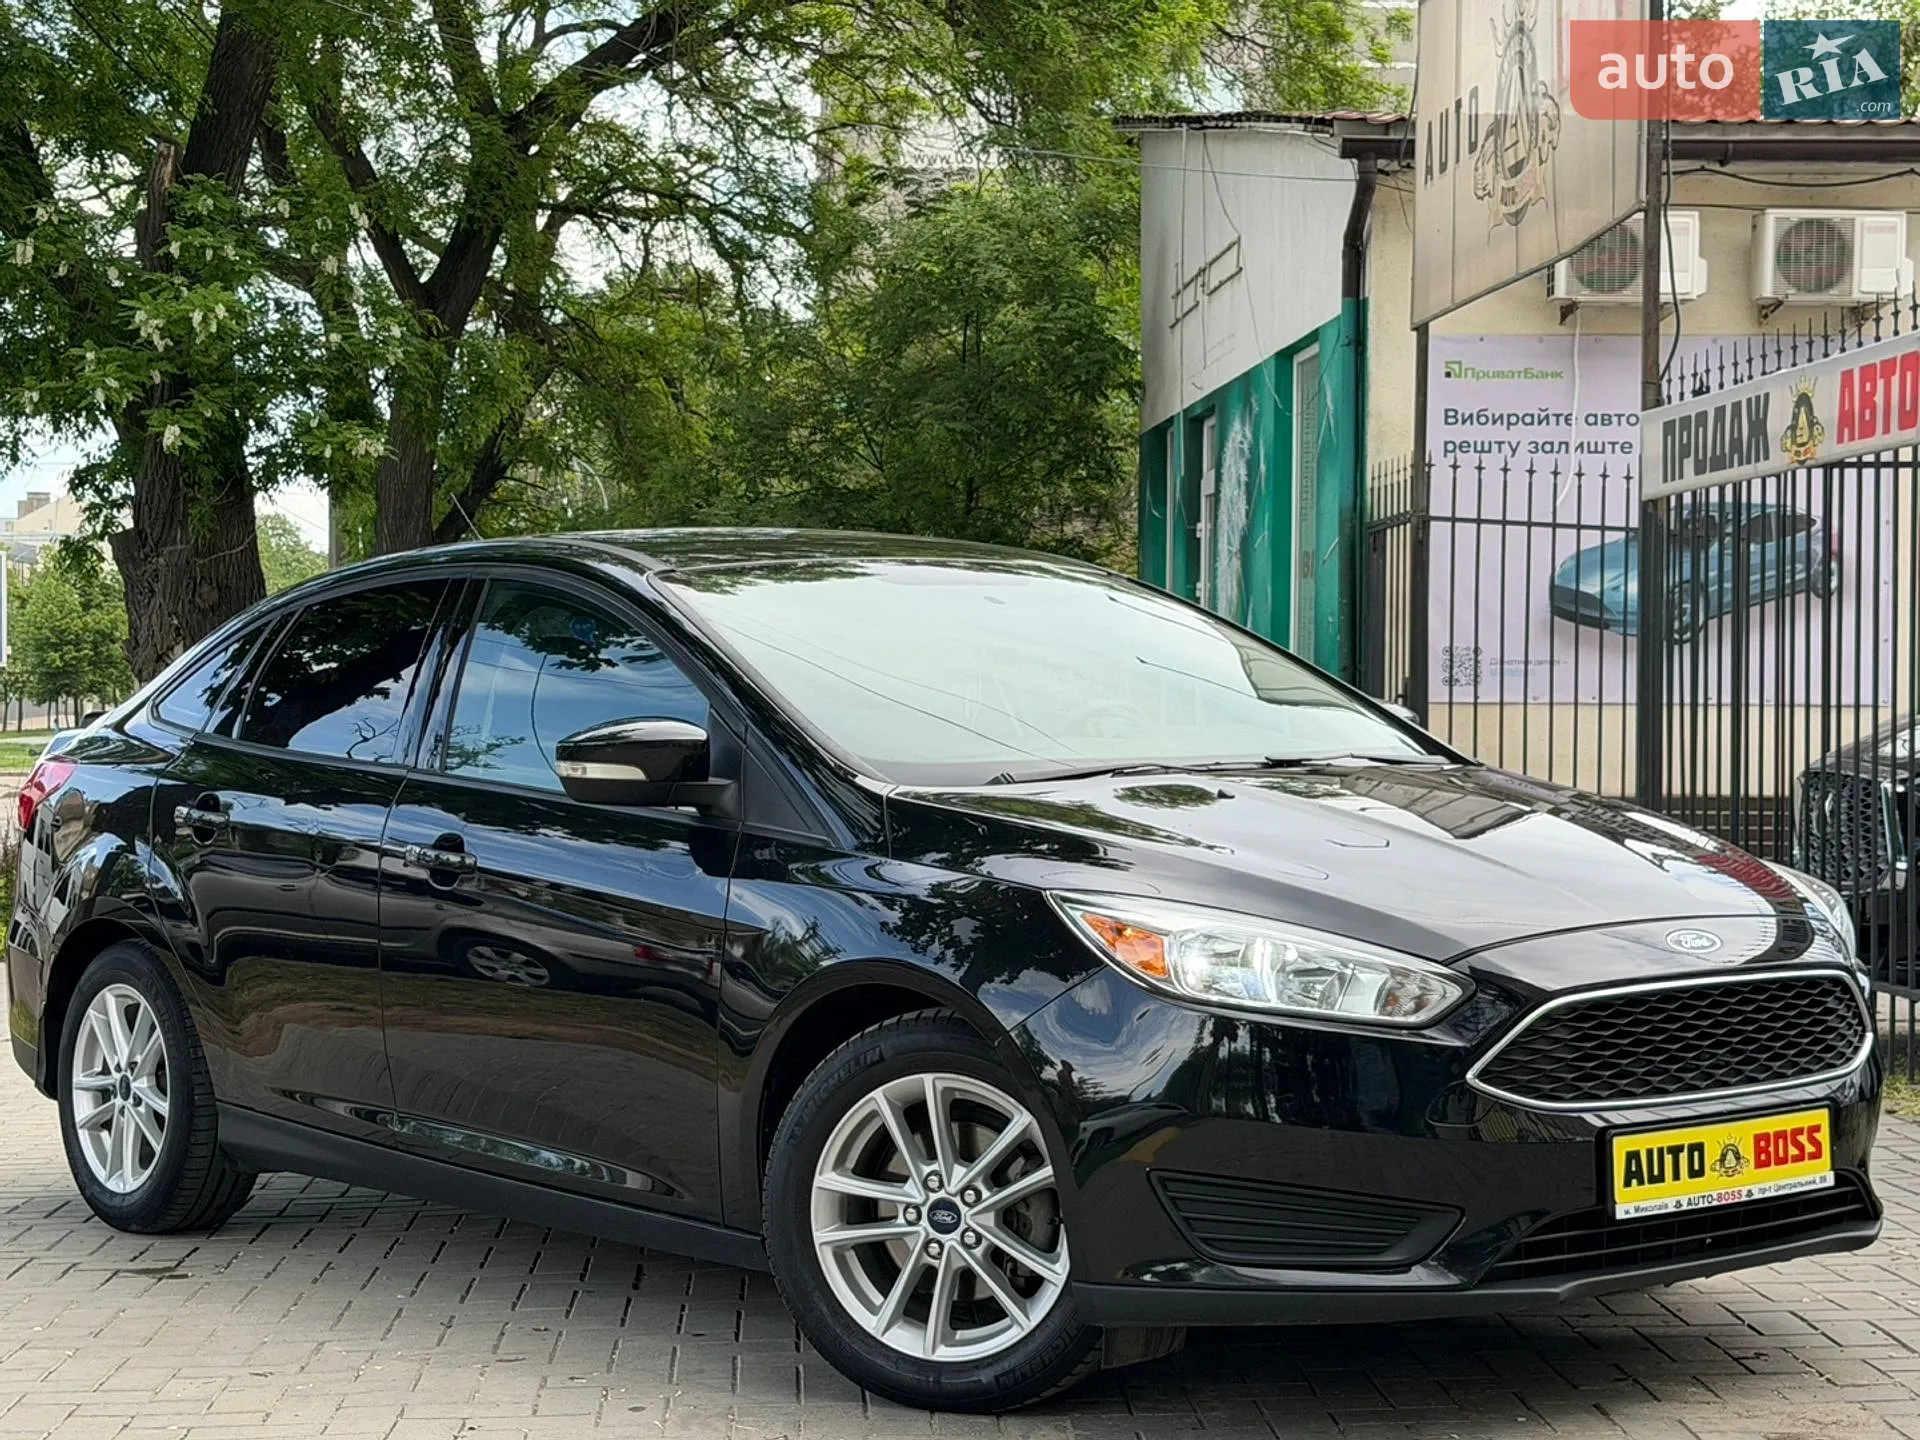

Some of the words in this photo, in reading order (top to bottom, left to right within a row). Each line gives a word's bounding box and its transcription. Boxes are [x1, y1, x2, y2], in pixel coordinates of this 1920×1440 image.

[1424, 85, 1479, 187] AUTO
[1463, 367, 1564, 382] ПриватБанк
[1443, 407, 1577, 431] Вибирайте
[1584, 411, 1640, 427] авто
[1662, 391, 1771, 484] ПРОДАЖ
[1836, 350, 1920, 445] АВТО
[1443, 439, 1521, 459] решту
[1527, 439, 1634, 455] залиште
[1623, 1141, 1705, 1189] AUTO
[1753, 1123, 1823, 1170] BOSS
[1686, 1189, 1743, 1208] AUTO-BOSS
